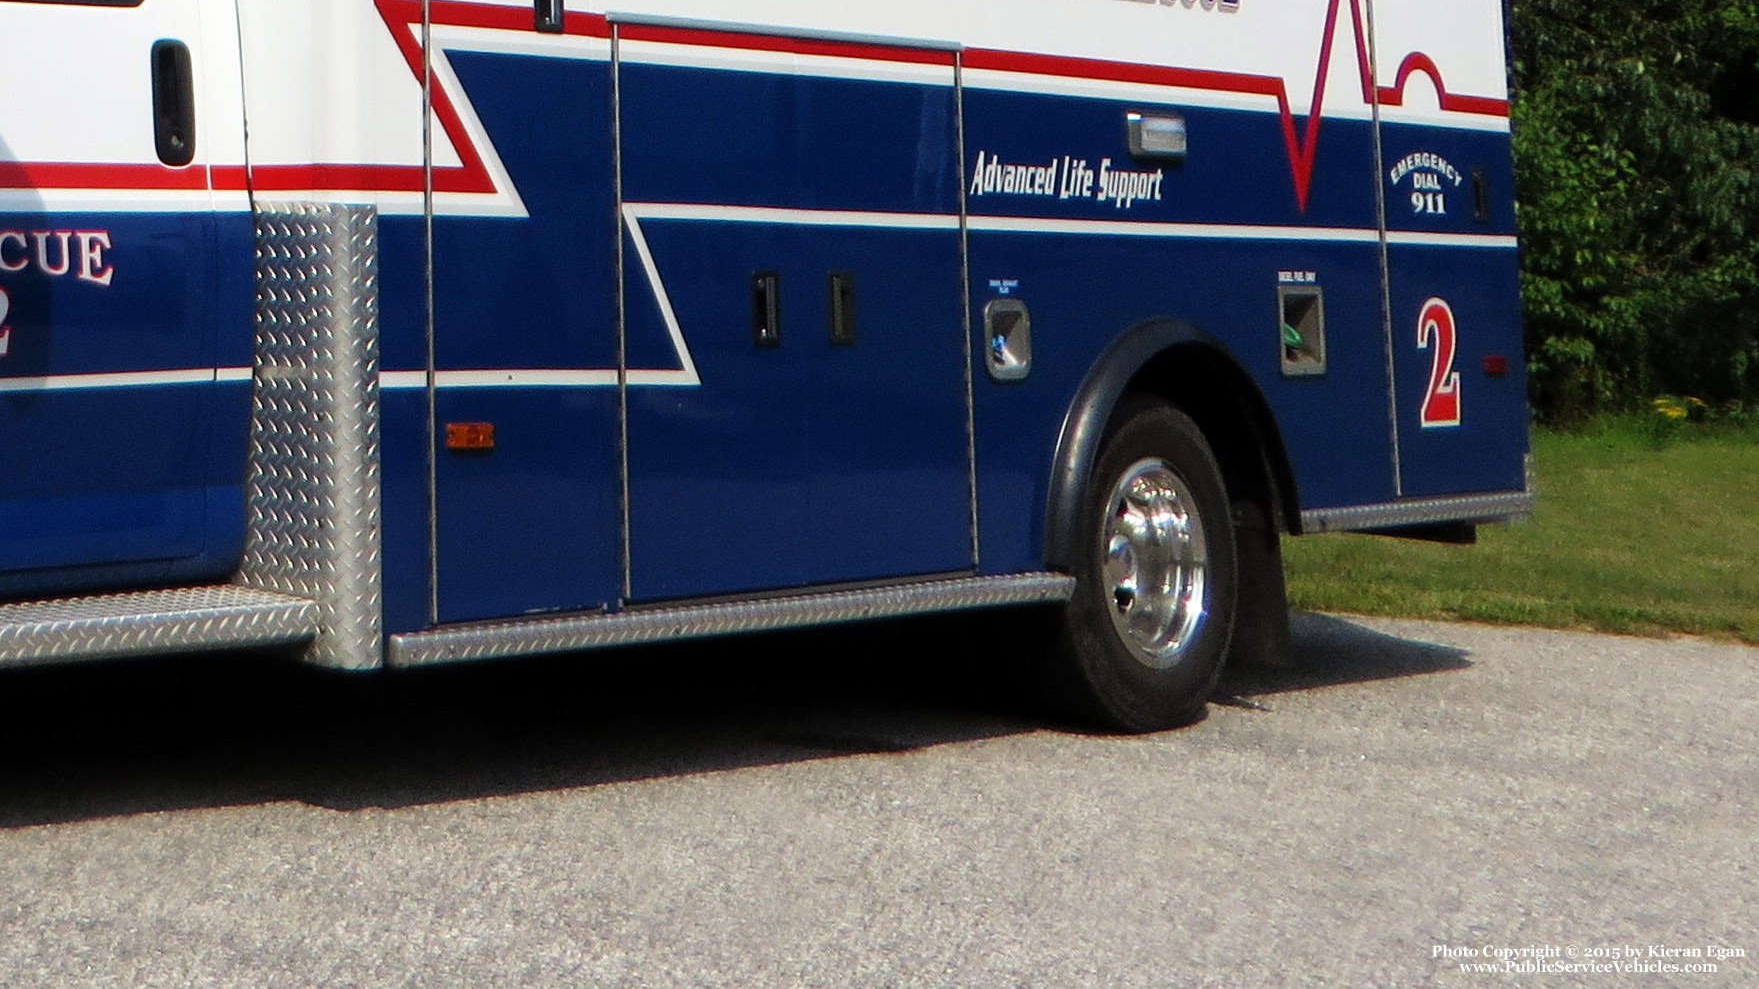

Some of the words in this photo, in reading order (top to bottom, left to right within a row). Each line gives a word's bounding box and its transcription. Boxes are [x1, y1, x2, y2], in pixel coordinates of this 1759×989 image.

[970, 150, 1058, 196] Advanced
[1060, 155, 1094, 199] Life
[1096, 158, 1164, 208] Support
[1390, 152, 1462, 186] EMERGENCY
[1413, 172, 1442, 190] DIAL
[1410, 192, 1447, 214] 911
[1417, 297, 1460, 427] 2
